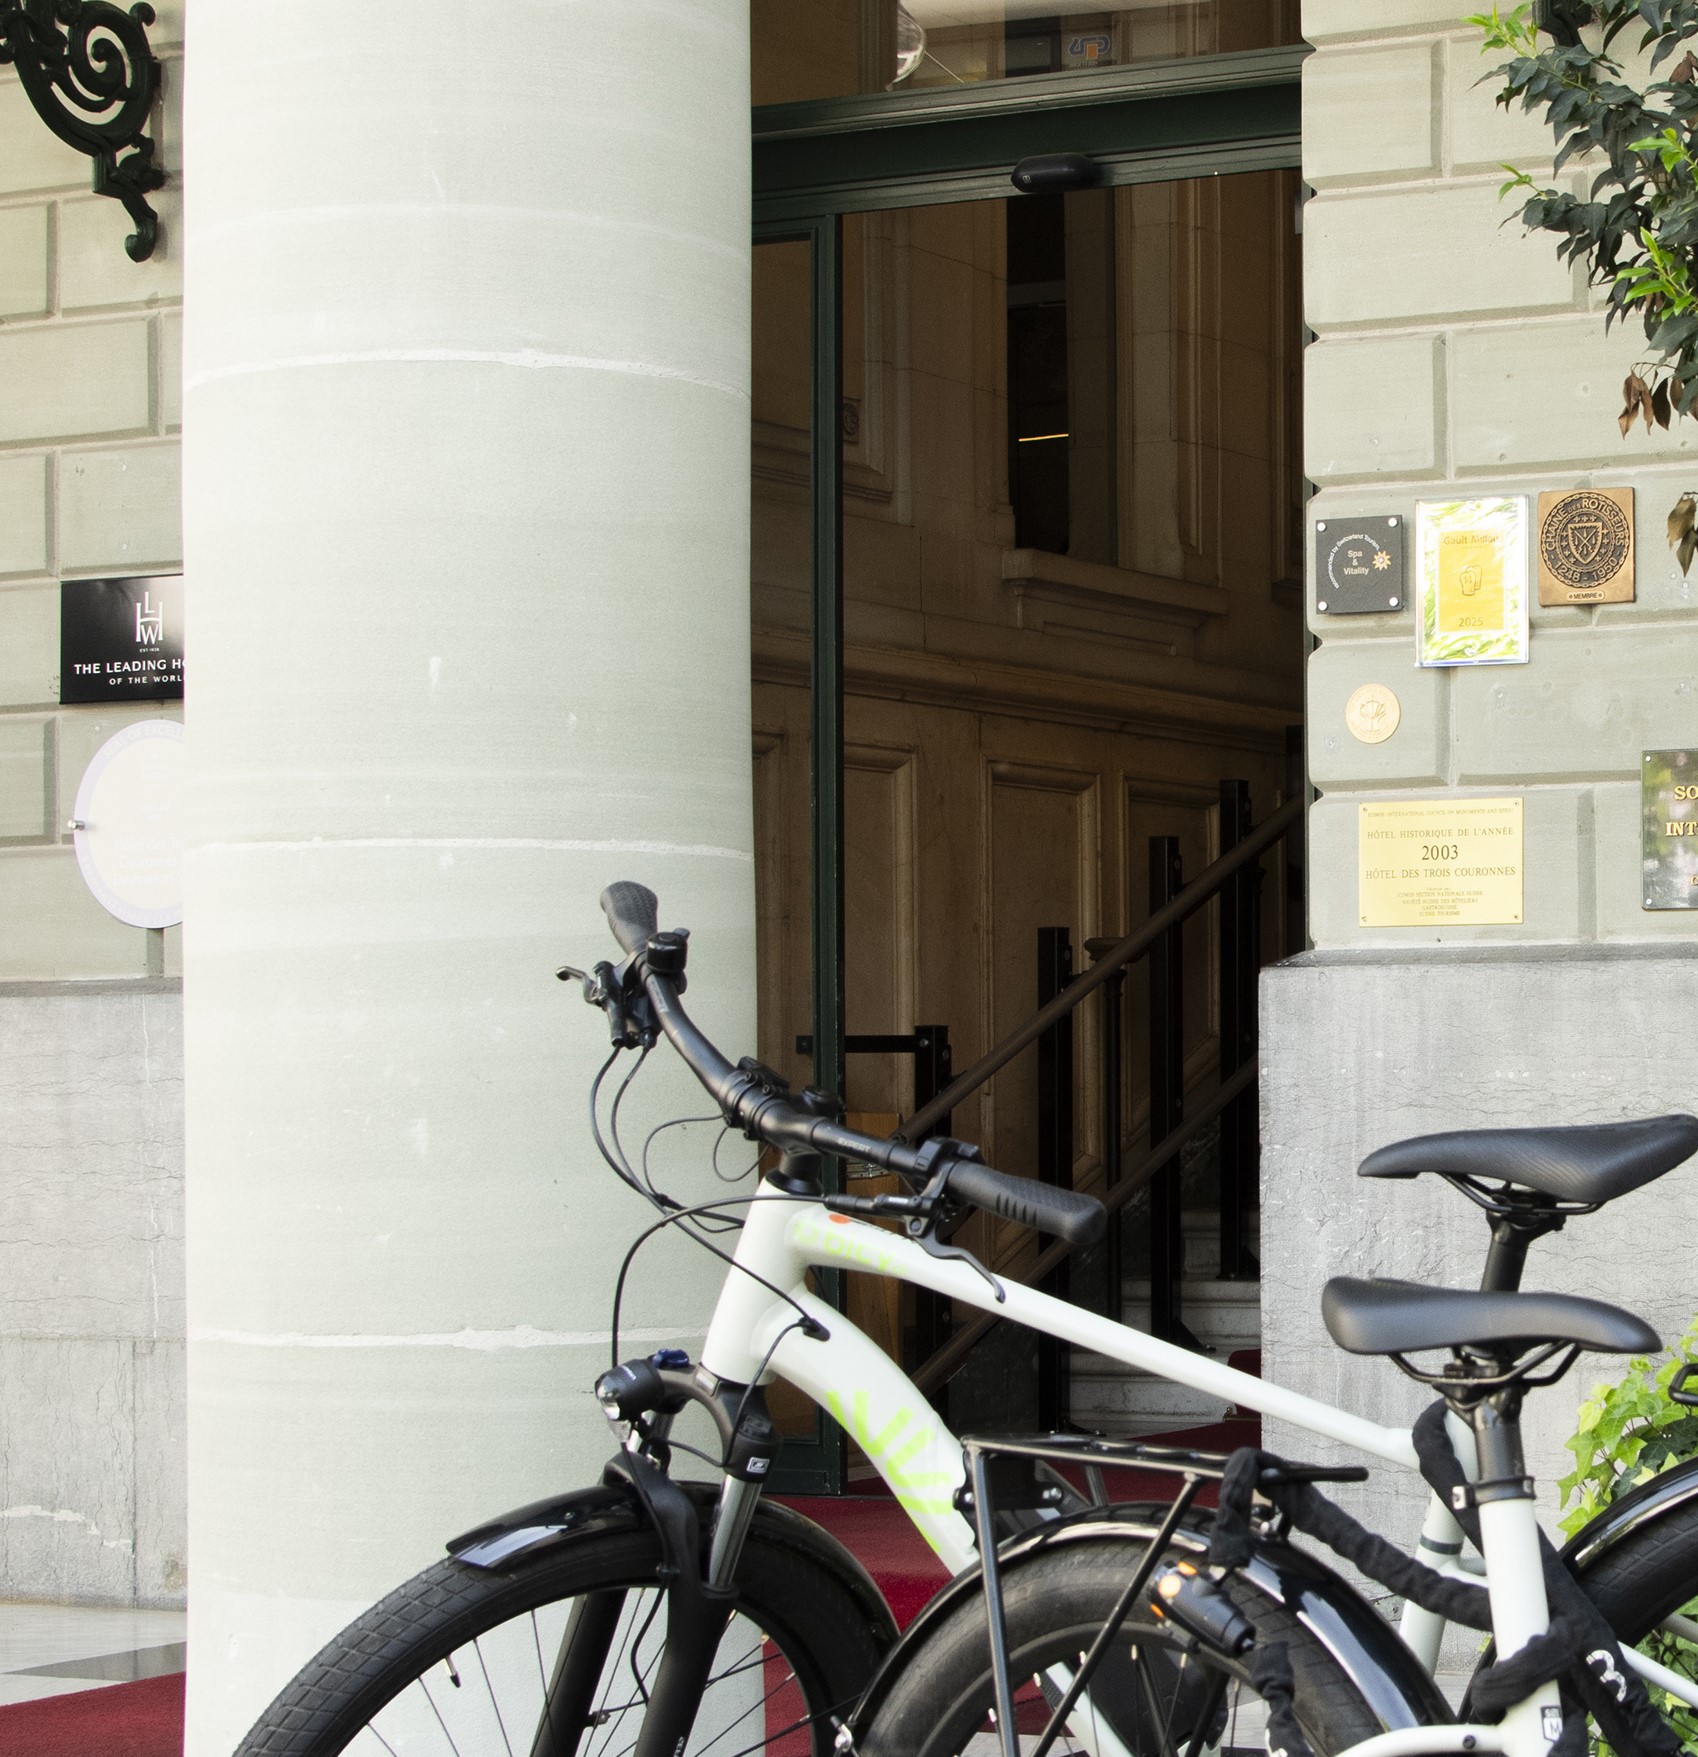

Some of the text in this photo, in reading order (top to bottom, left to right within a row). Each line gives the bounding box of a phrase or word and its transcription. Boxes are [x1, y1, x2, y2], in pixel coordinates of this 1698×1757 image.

[1546, 508, 1568, 550] CHAINE
[1582, 498, 1625, 546] ROTISSEURS
[1347, 550, 1363, 559] Spa
[1343, 567, 1370, 576] Vitality
[1554, 557, 1618, 582] 1248 1950
[1458, 617, 1484, 628] 2025
[74, 663, 101, 675] THE
[106, 660, 167, 673] LEADING
[109, 678, 123, 686] OF
[128, 676, 148, 684] THE
[1367, 825, 1514, 839] HÔTEL HISTORIQUE DE L'ANNÉE
[1421, 844, 1459, 861] 2003
[1366, 866, 1516, 880] HÔTEL DES TROIS COURONNES
